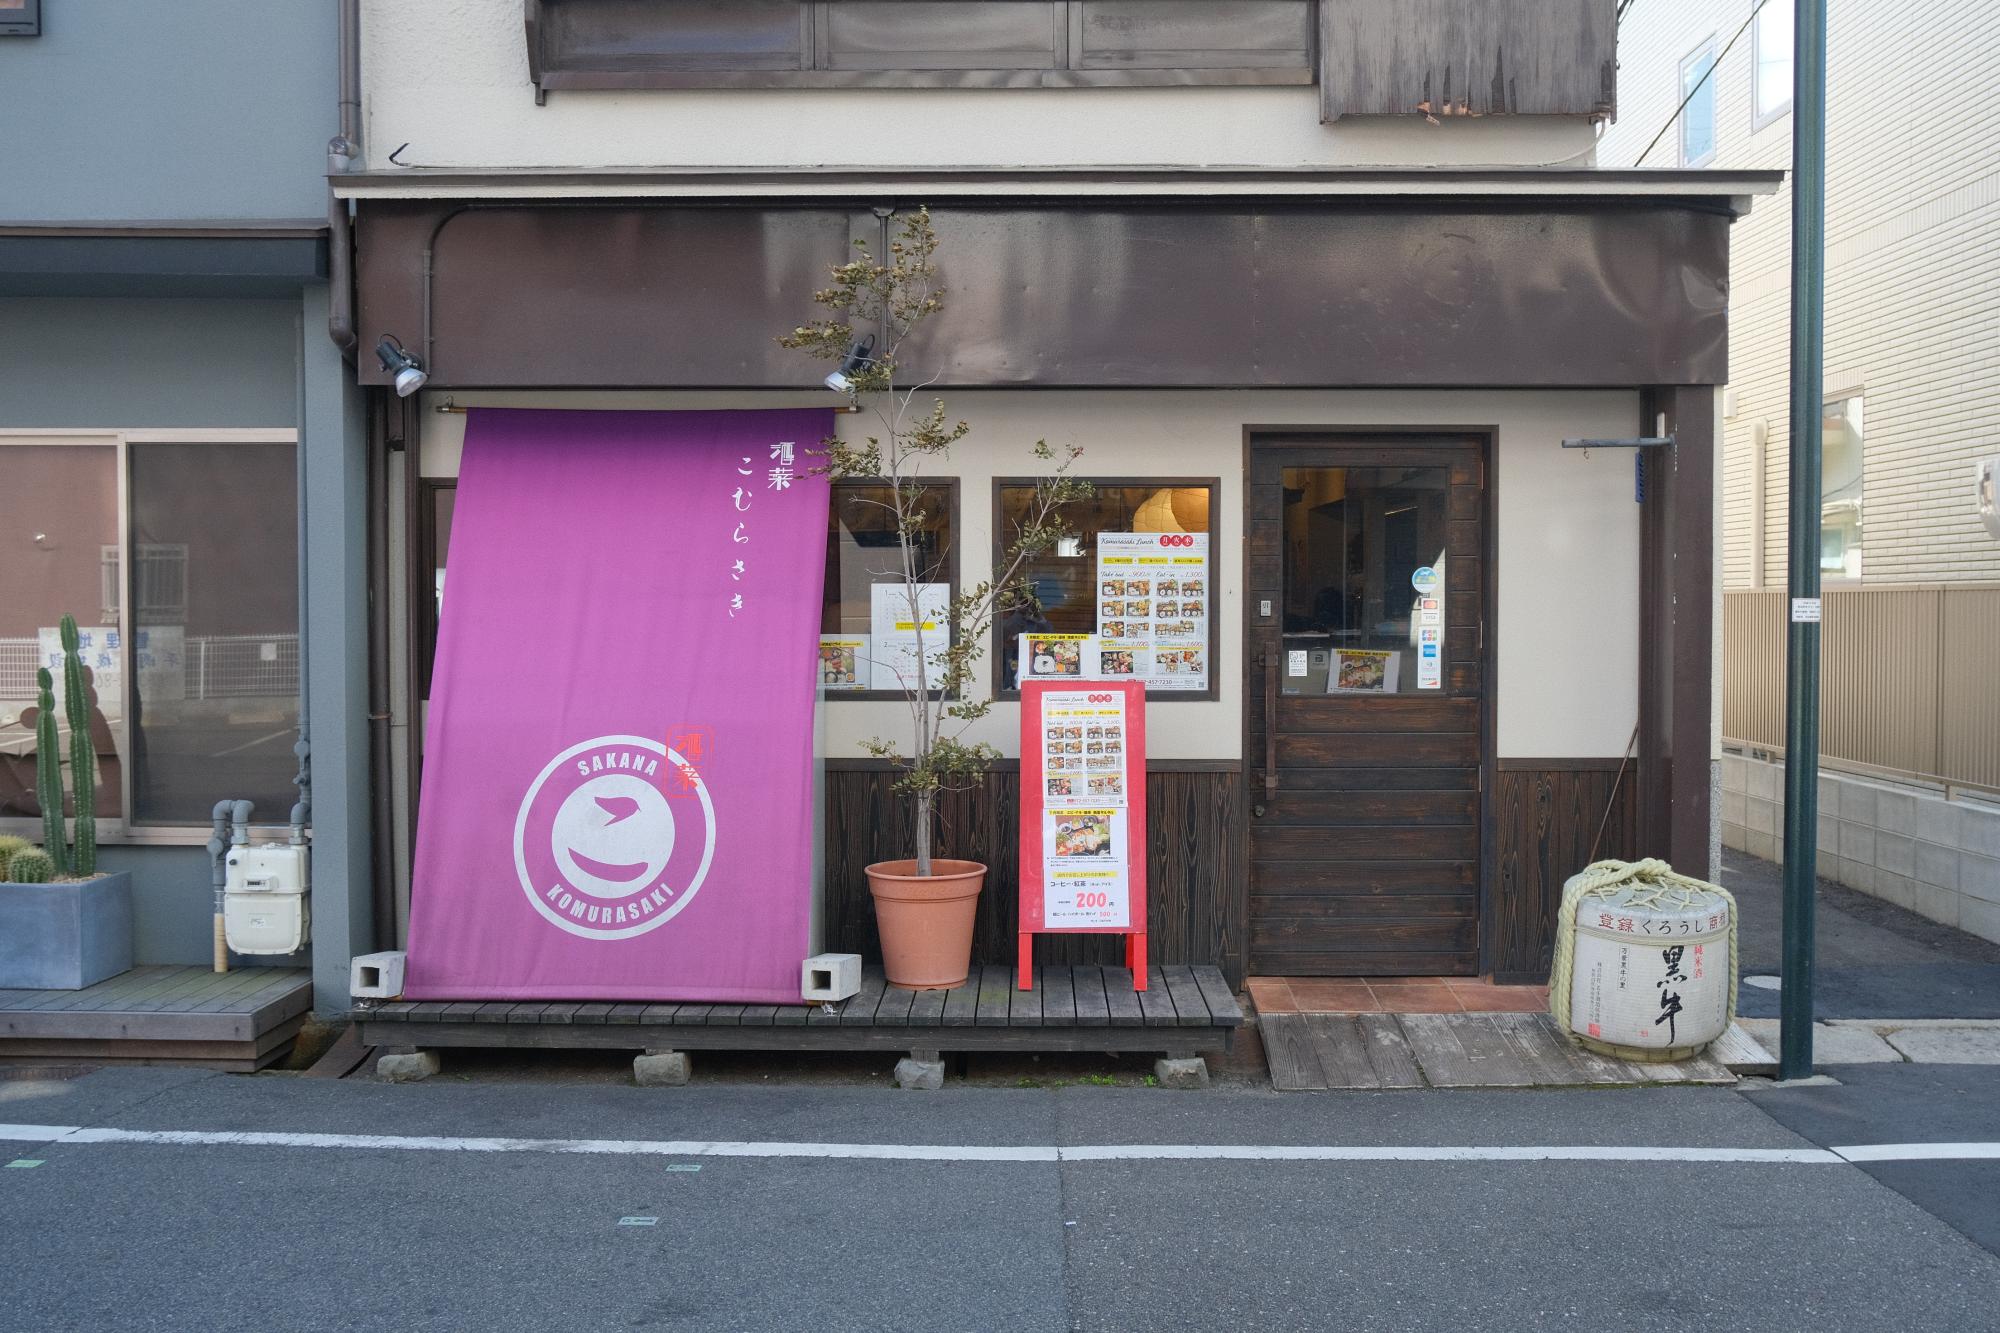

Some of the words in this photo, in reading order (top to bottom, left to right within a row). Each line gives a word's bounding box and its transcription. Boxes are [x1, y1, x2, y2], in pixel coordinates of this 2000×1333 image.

[729, 457, 753, 618] こむらさき
[577, 752, 659, 777] SAKANA
[546, 883, 674, 924] KOMURASAKI
[1076, 892, 1107, 908] 200
[1598, 913, 1634, 933] 登録
[1642, 919, 1703, 935] くろうし
[1655, 945, 1688, 1047] 黒牛
